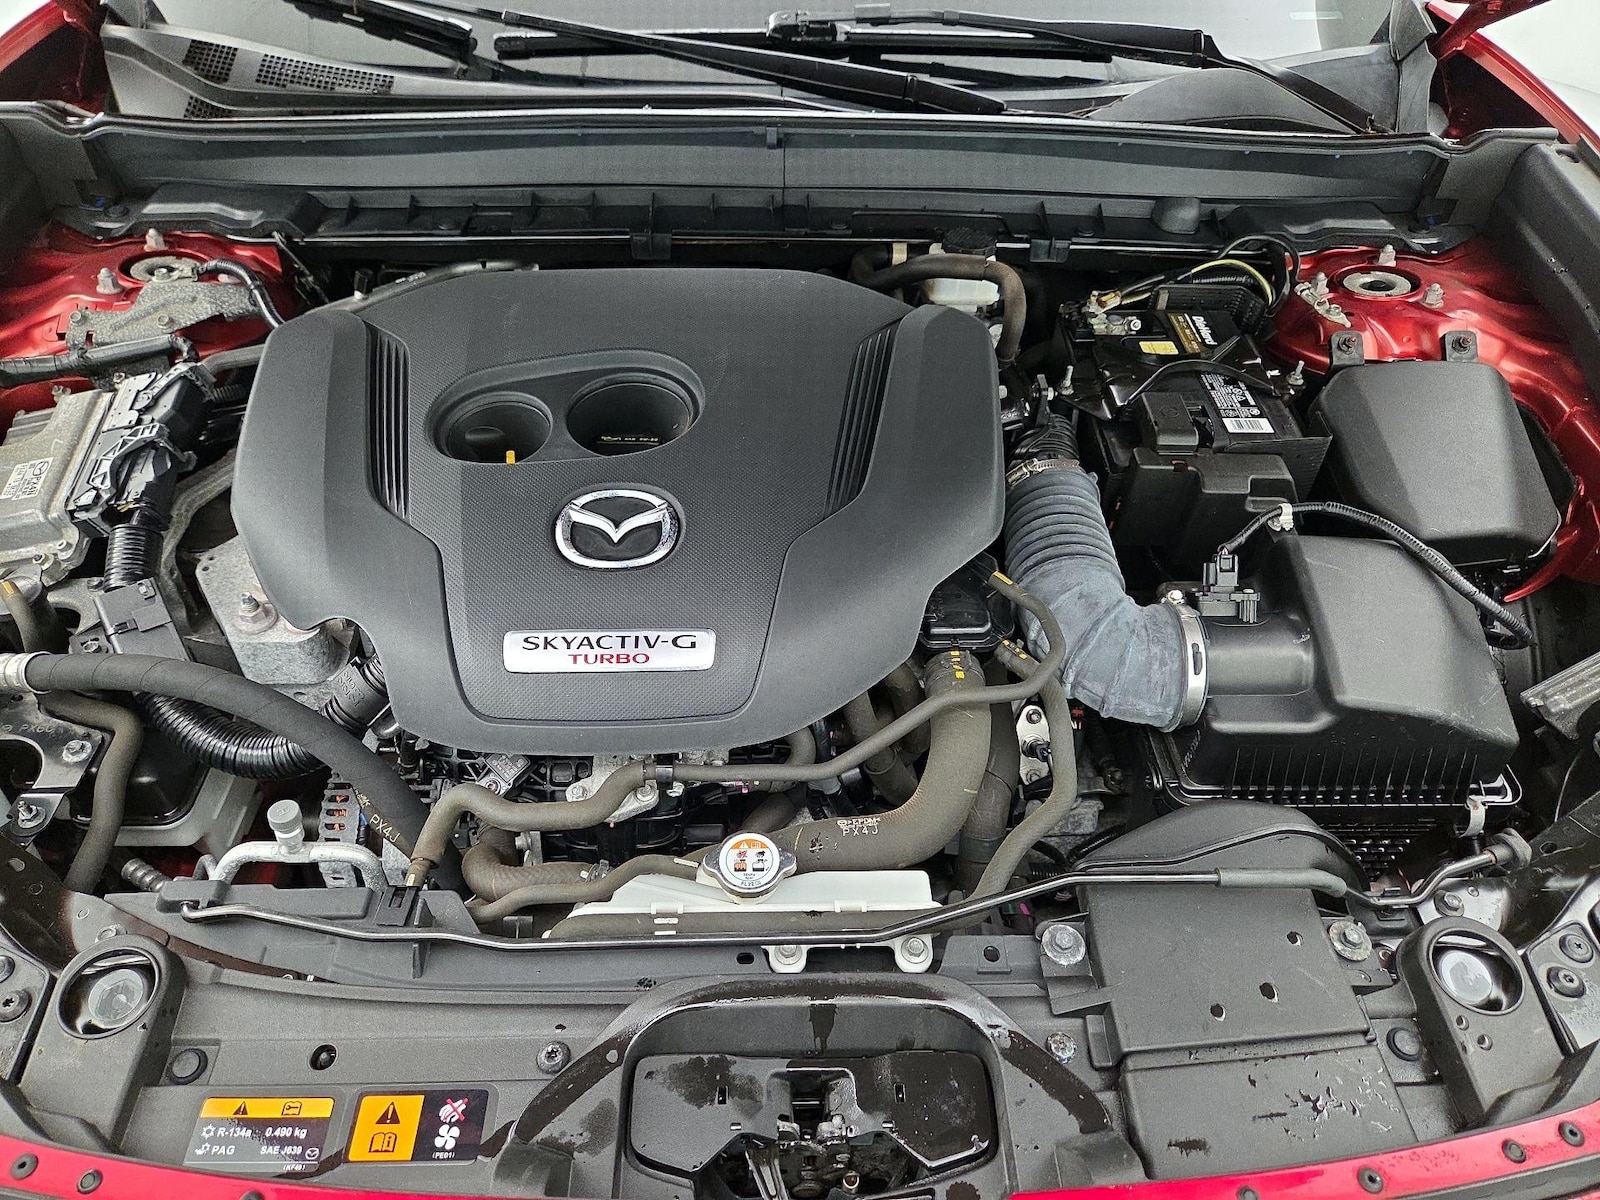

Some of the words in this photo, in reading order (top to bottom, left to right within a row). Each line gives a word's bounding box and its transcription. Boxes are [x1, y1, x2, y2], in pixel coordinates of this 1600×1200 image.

[1192, 316, 1218, 345] DieHard
[522, 634, 697, 650] SKYACTIV-G
[568, 653, 650, 665] TURBO
[369, 813, 401, 843] PX4J
[842, 825, 879, 836] PX4J
[217, 1127, 252, 1137] R-134a
[265, 1127, 291, 1137] 0.490
[294, 1127, 307, 1139] kg
[211, 1145, 236, 1155] PAG
[260, 1146, 280, 1155] SAE
[281, 1146, 303, 1155] J639
